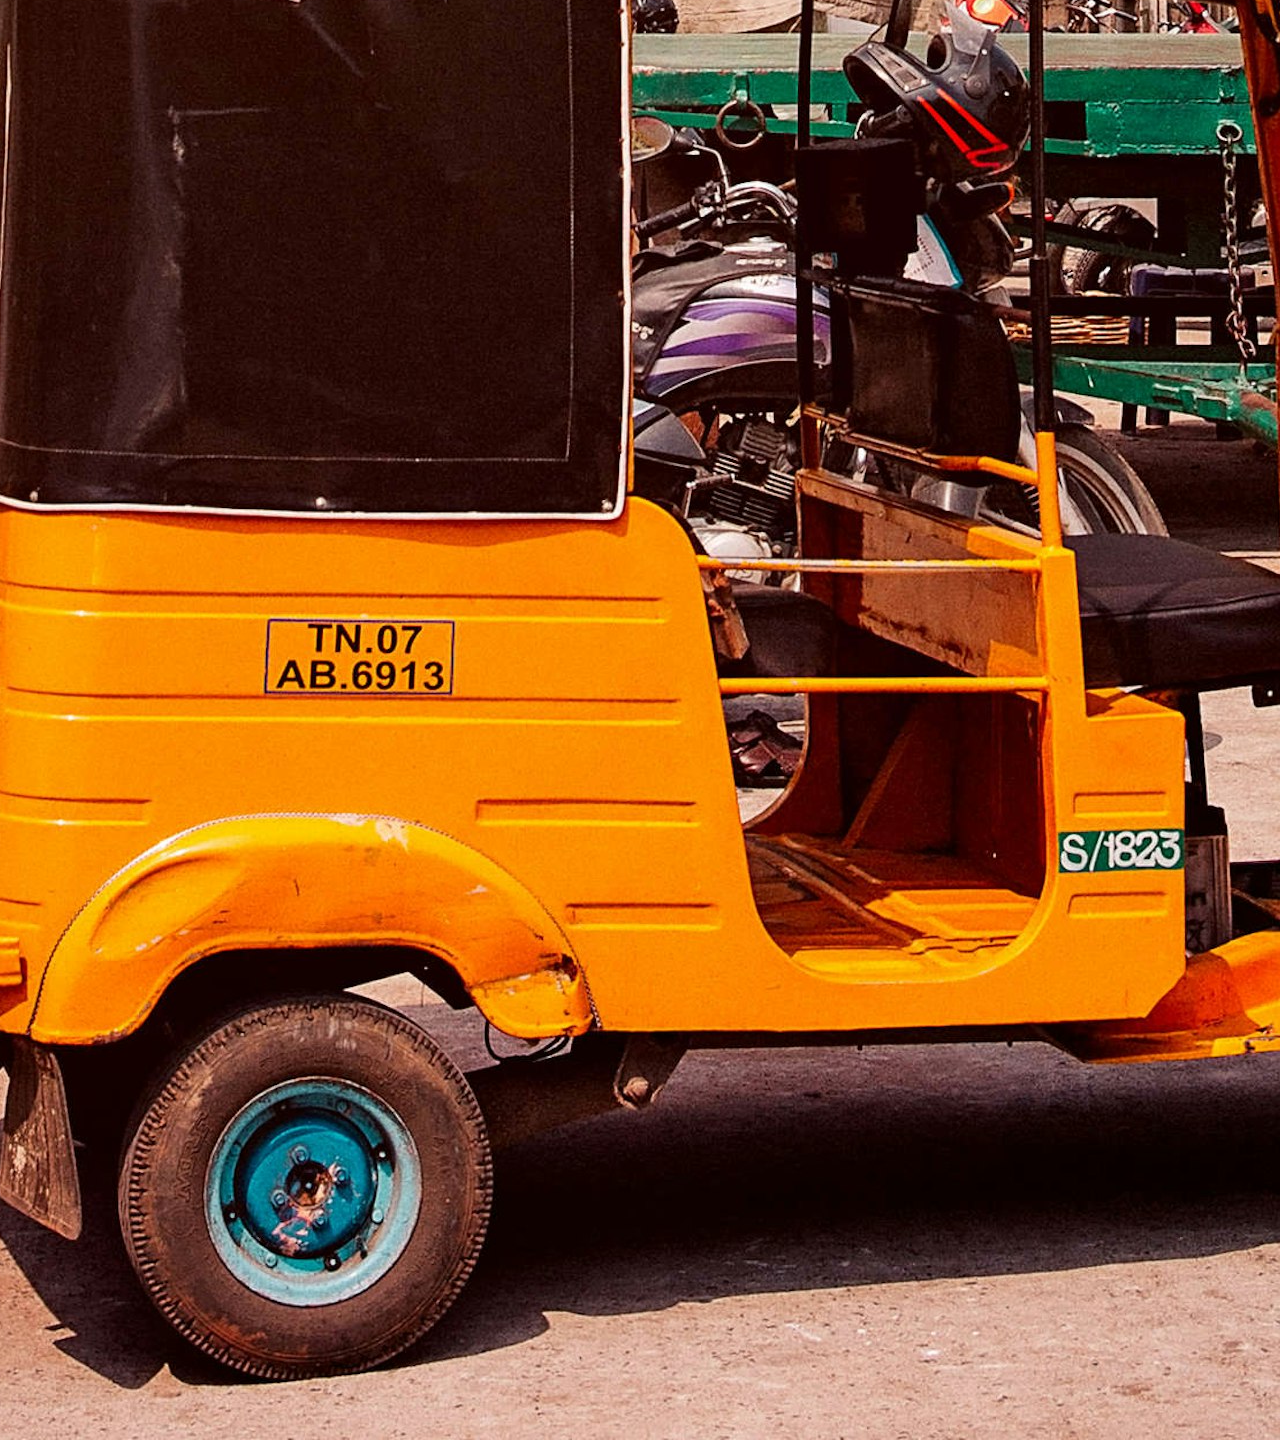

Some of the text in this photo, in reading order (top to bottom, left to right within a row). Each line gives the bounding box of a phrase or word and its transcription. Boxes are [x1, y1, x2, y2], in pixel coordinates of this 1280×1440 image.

[307, 623, 423, 655] TN.07
[275, 659, 445, 691] AB.6913
[1060, 830, 1181, 872] S/1823
